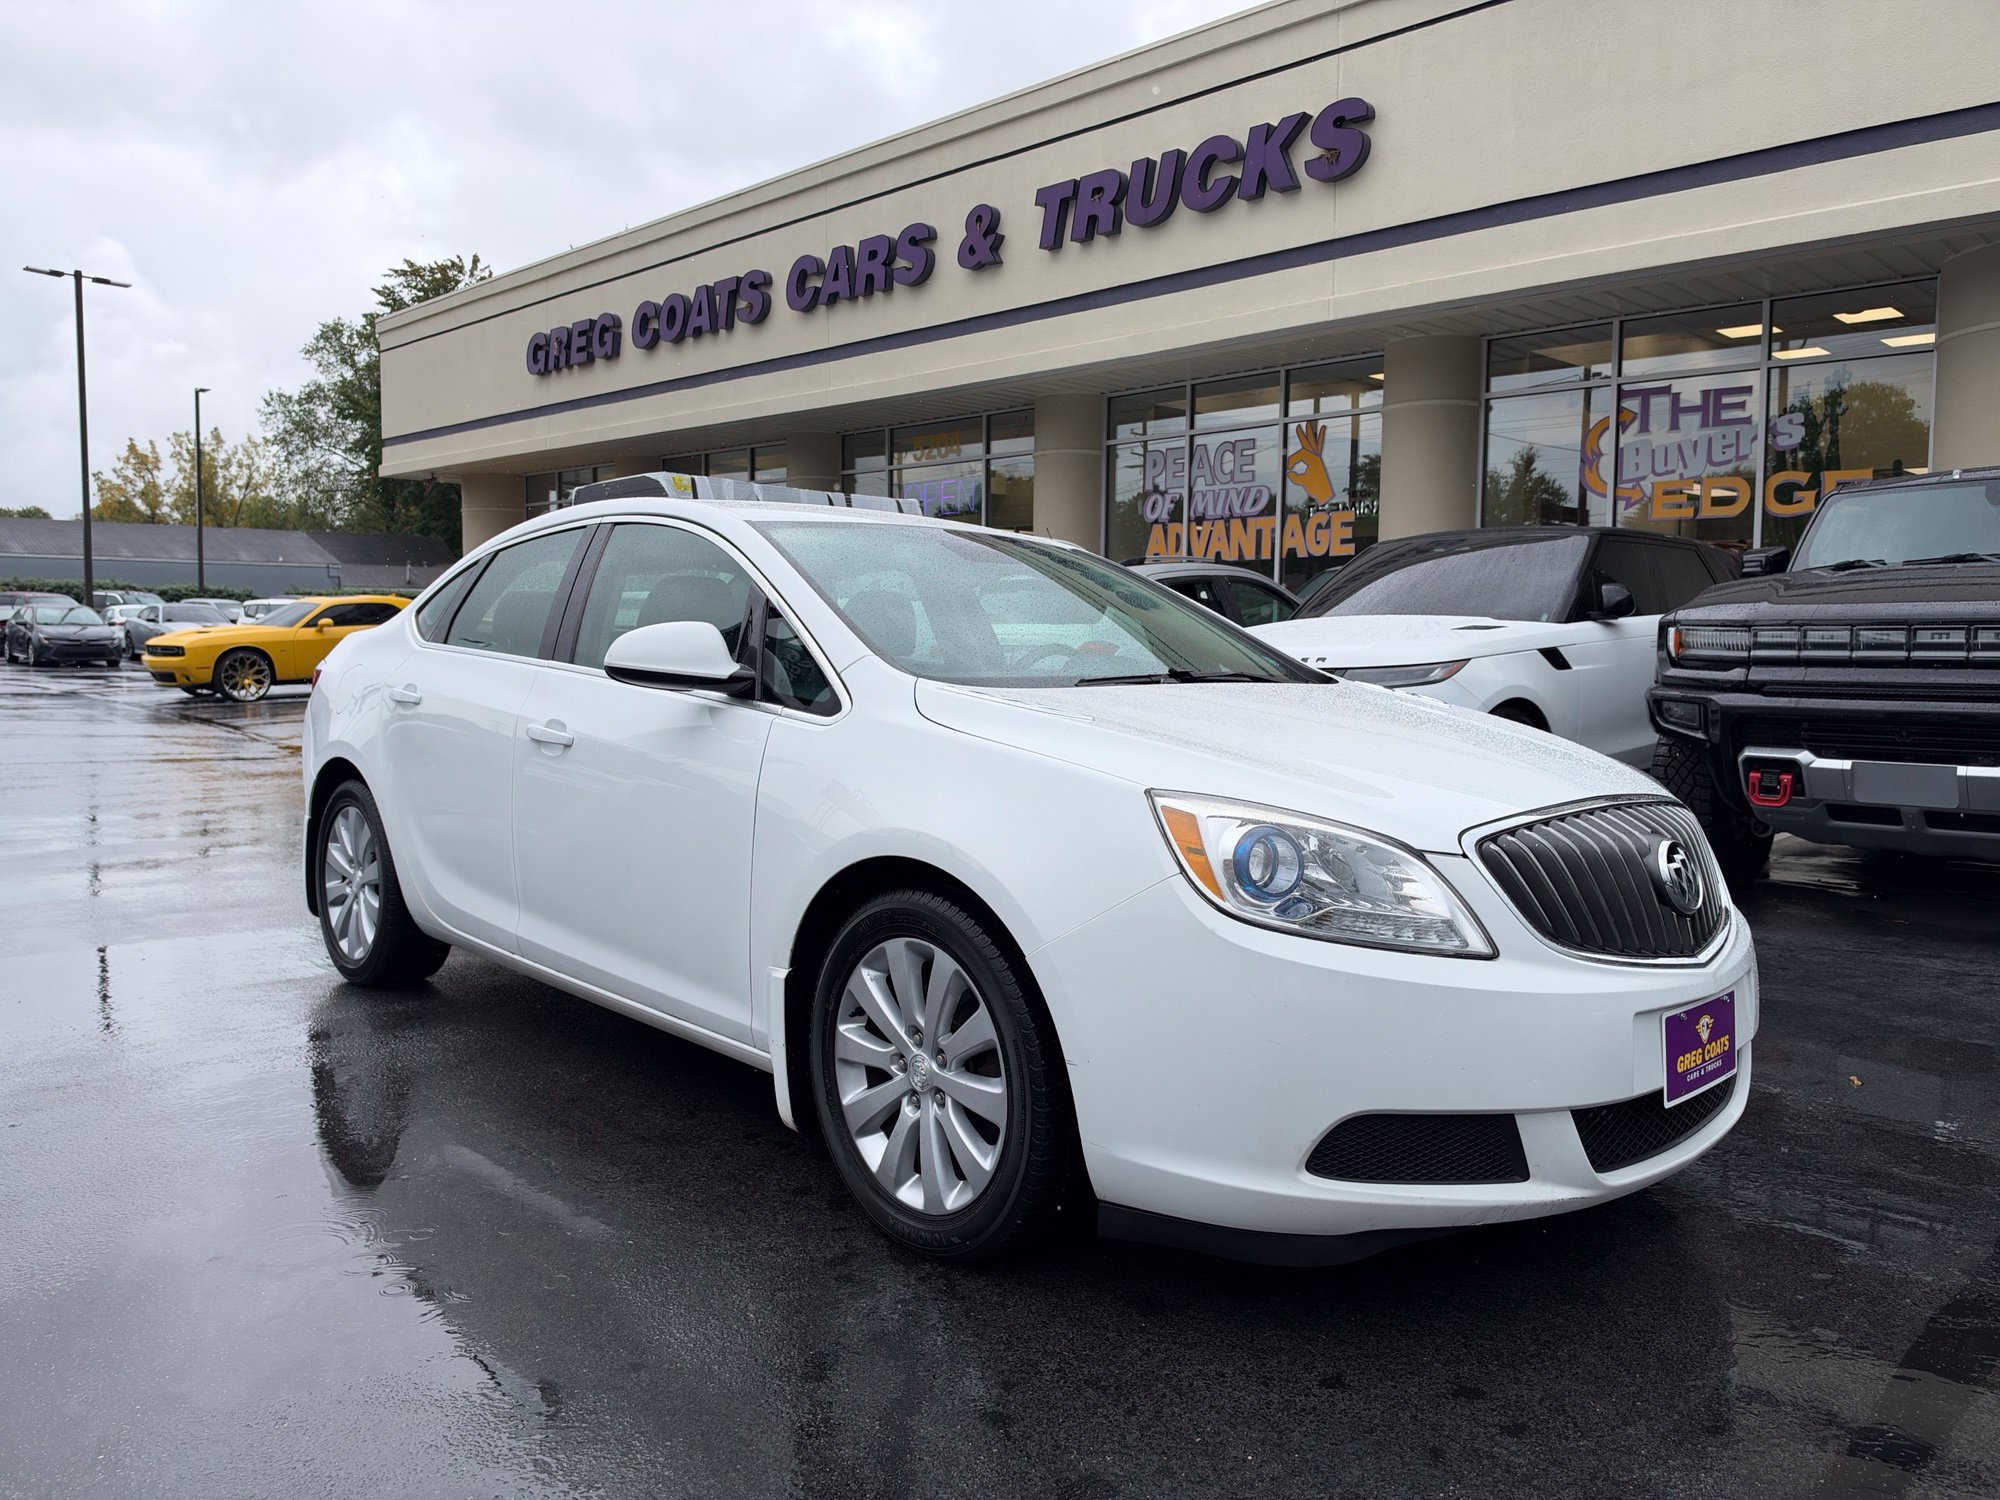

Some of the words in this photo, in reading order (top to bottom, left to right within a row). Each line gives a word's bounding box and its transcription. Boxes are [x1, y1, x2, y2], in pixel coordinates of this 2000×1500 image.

[526, 312, 622, 376] GREG
[632, 269, 773, 350] COATS
[786, 222, 938, 313] CARS
[957, 203, 1005, 271] &
[1035, 97, 1376, 252] TRUCKS
[1621, 384, 1753, 437] THE
[912, 431, 961, 462] 5204
[1145, 438, 1256, 493] PEACE
[1618, 412, 1806, 486] Buyer's
[1143, 494, 1183, 523] OF
[1190, 485, 1272, 520] MIND
[1144, 511, 1356, 563] ADVANTAGE
[1677, 1047, 1703, 1073] GREG
[1704, 1034, 1730, 1061] COATS
[1686, 1070, 1700, 1082] CARS
[1705, 1058, 1722, 1073] TRUCKS
